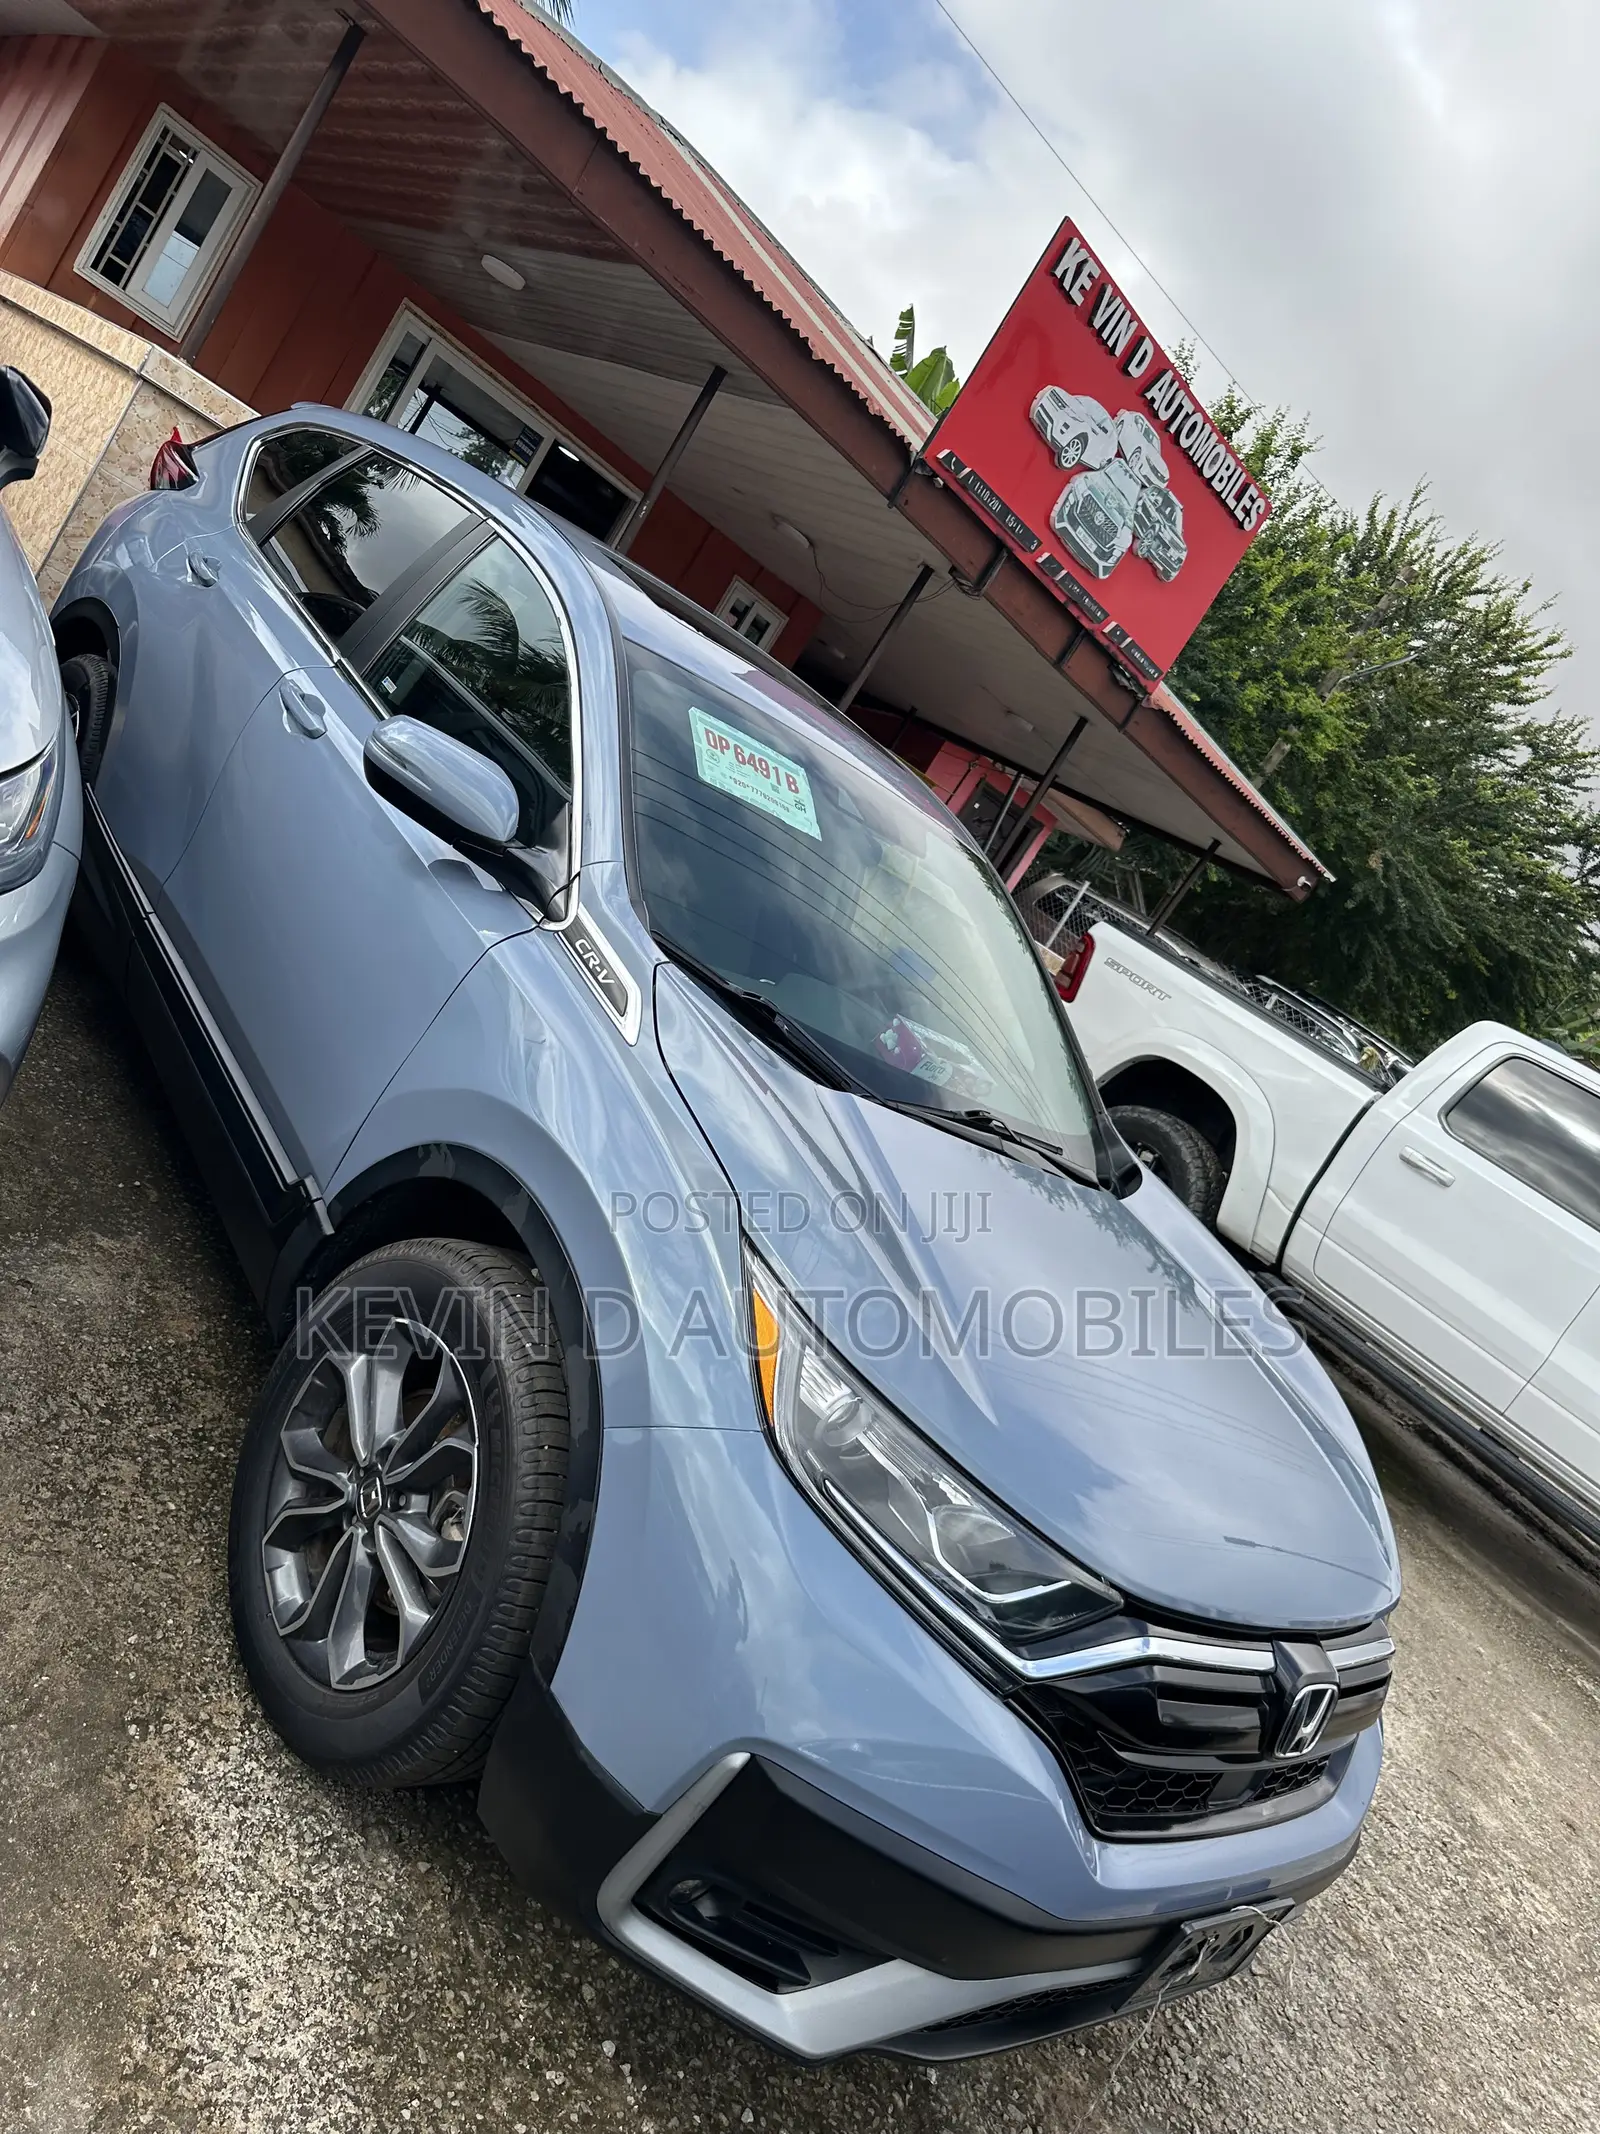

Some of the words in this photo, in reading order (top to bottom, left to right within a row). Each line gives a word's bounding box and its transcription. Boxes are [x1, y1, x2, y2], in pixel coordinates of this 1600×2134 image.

[1127, 336, 1154, 378] D
[1144, 369, 1266, 531] AUTOMOBILES
[734, 744, 781, 787] 6491
[785, 772, 800, 794] B
[575, 938, 615, 984] CR-V
[1104, 957, 1172, 1001] SPORT
